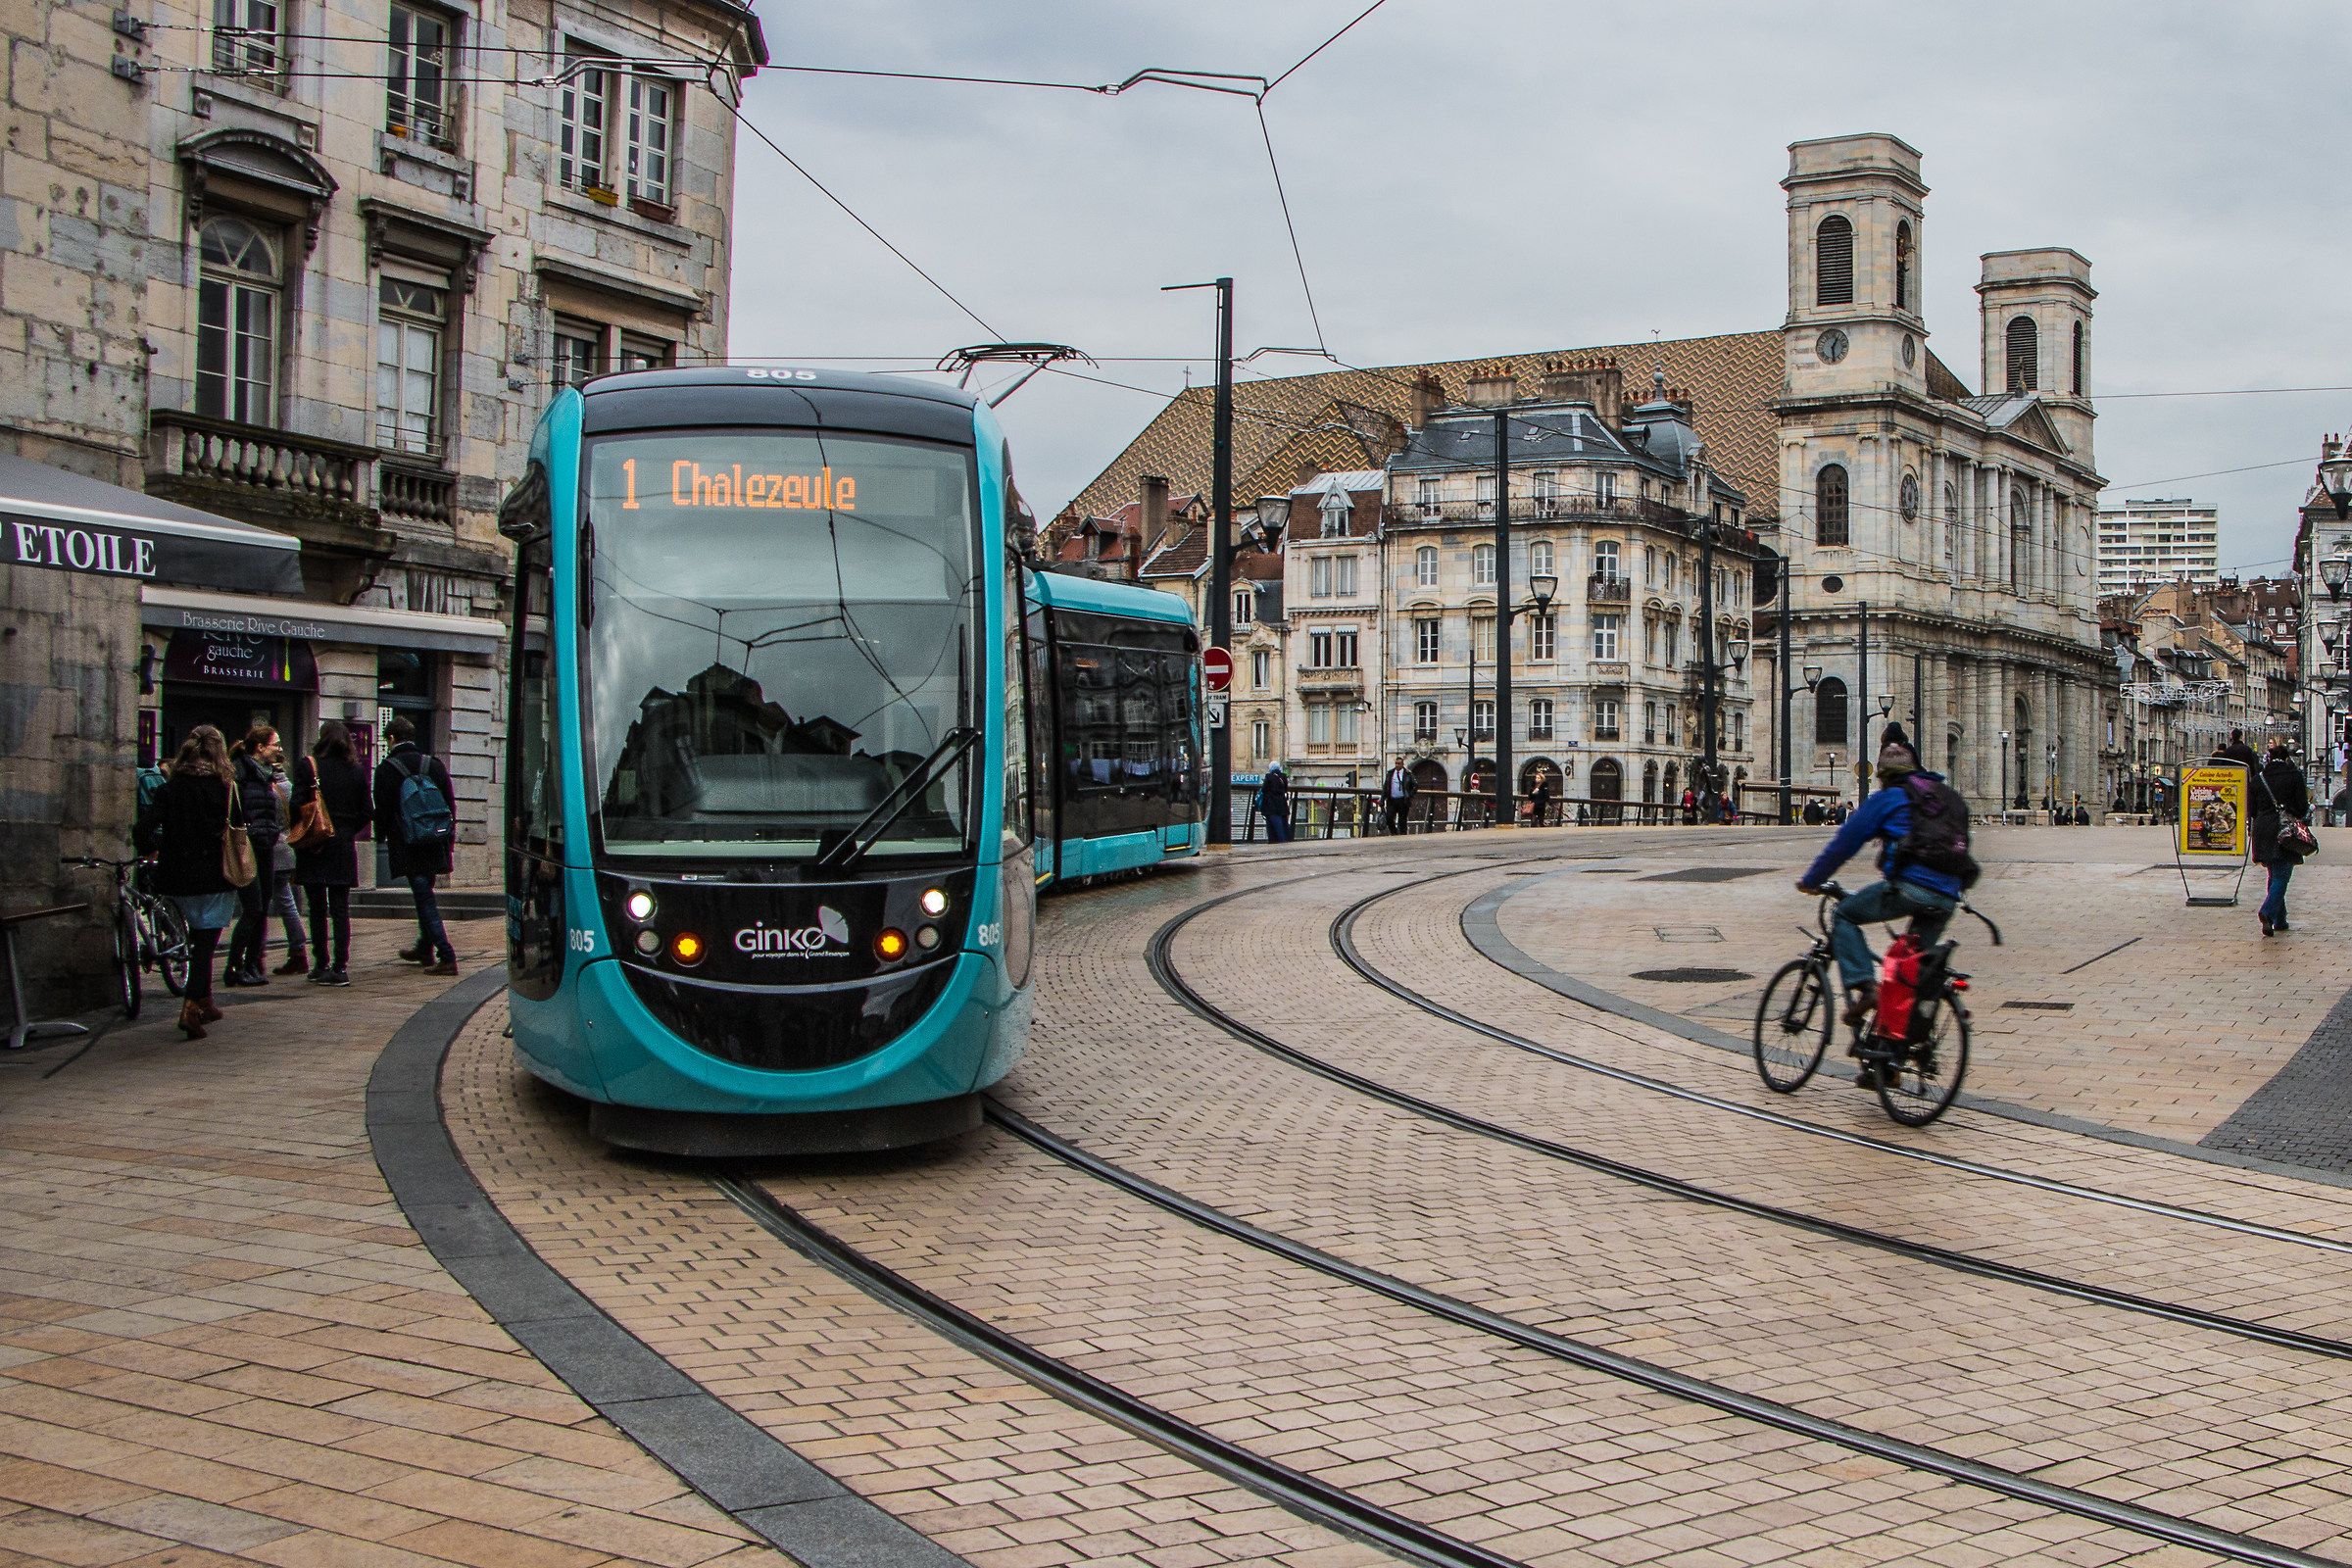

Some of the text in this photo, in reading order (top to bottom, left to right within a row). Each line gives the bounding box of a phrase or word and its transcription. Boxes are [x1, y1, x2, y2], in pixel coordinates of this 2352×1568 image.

[746, 368, 817, 380] 805
[622, 458, 856, 510] 1 Chalezeule
[12, 521, 157, 576] ETOILE
[182, 611, 325, 638] Brasserie Rive Gauche
[206, 643, 254, 662] gauche
[203, 664, 265, 679] BRASSERIE
[569, 928, 595, 953] 805
[978, 922, 1000, 947] 805
